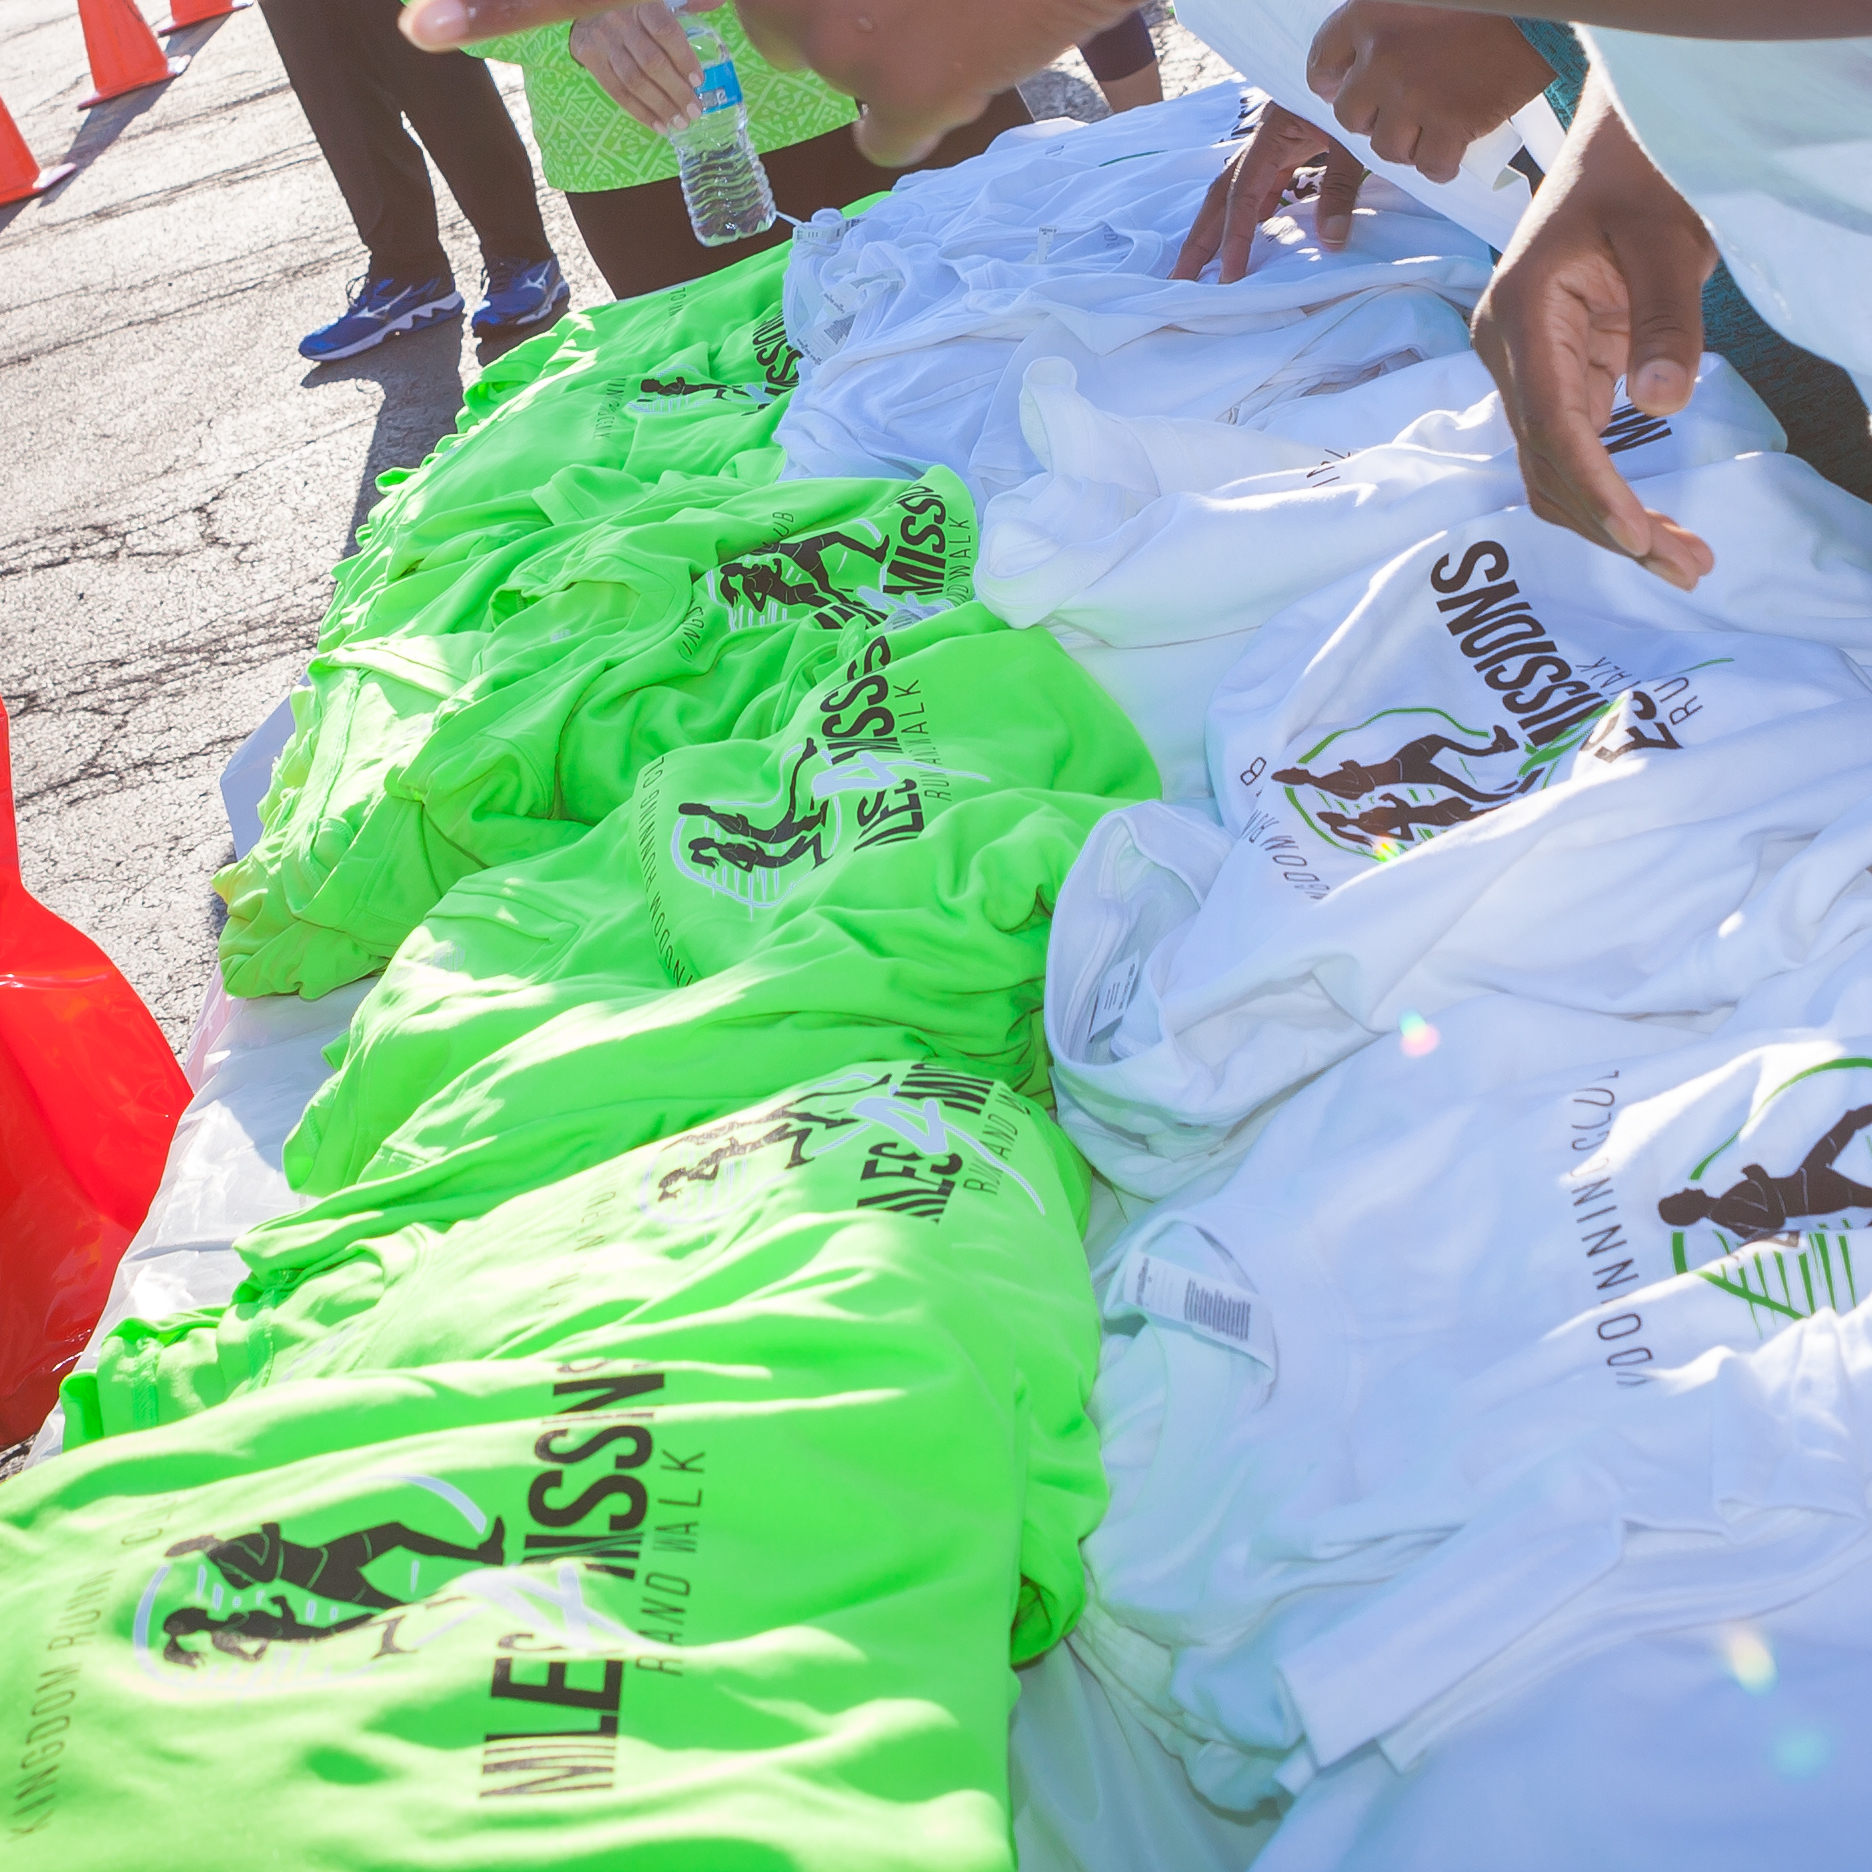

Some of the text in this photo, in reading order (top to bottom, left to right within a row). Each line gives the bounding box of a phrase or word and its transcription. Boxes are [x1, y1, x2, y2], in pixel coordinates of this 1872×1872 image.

[948, 517, 972, 581] WALK
[1576, 657, 1703, 725] RU ALK
[643, 756, 665, 788] CL
[649, 891, 694, 987] INGDOM
[1572, 1070, 1619, 1150] CLU
[652, 1449, 706, 1554] WALK
